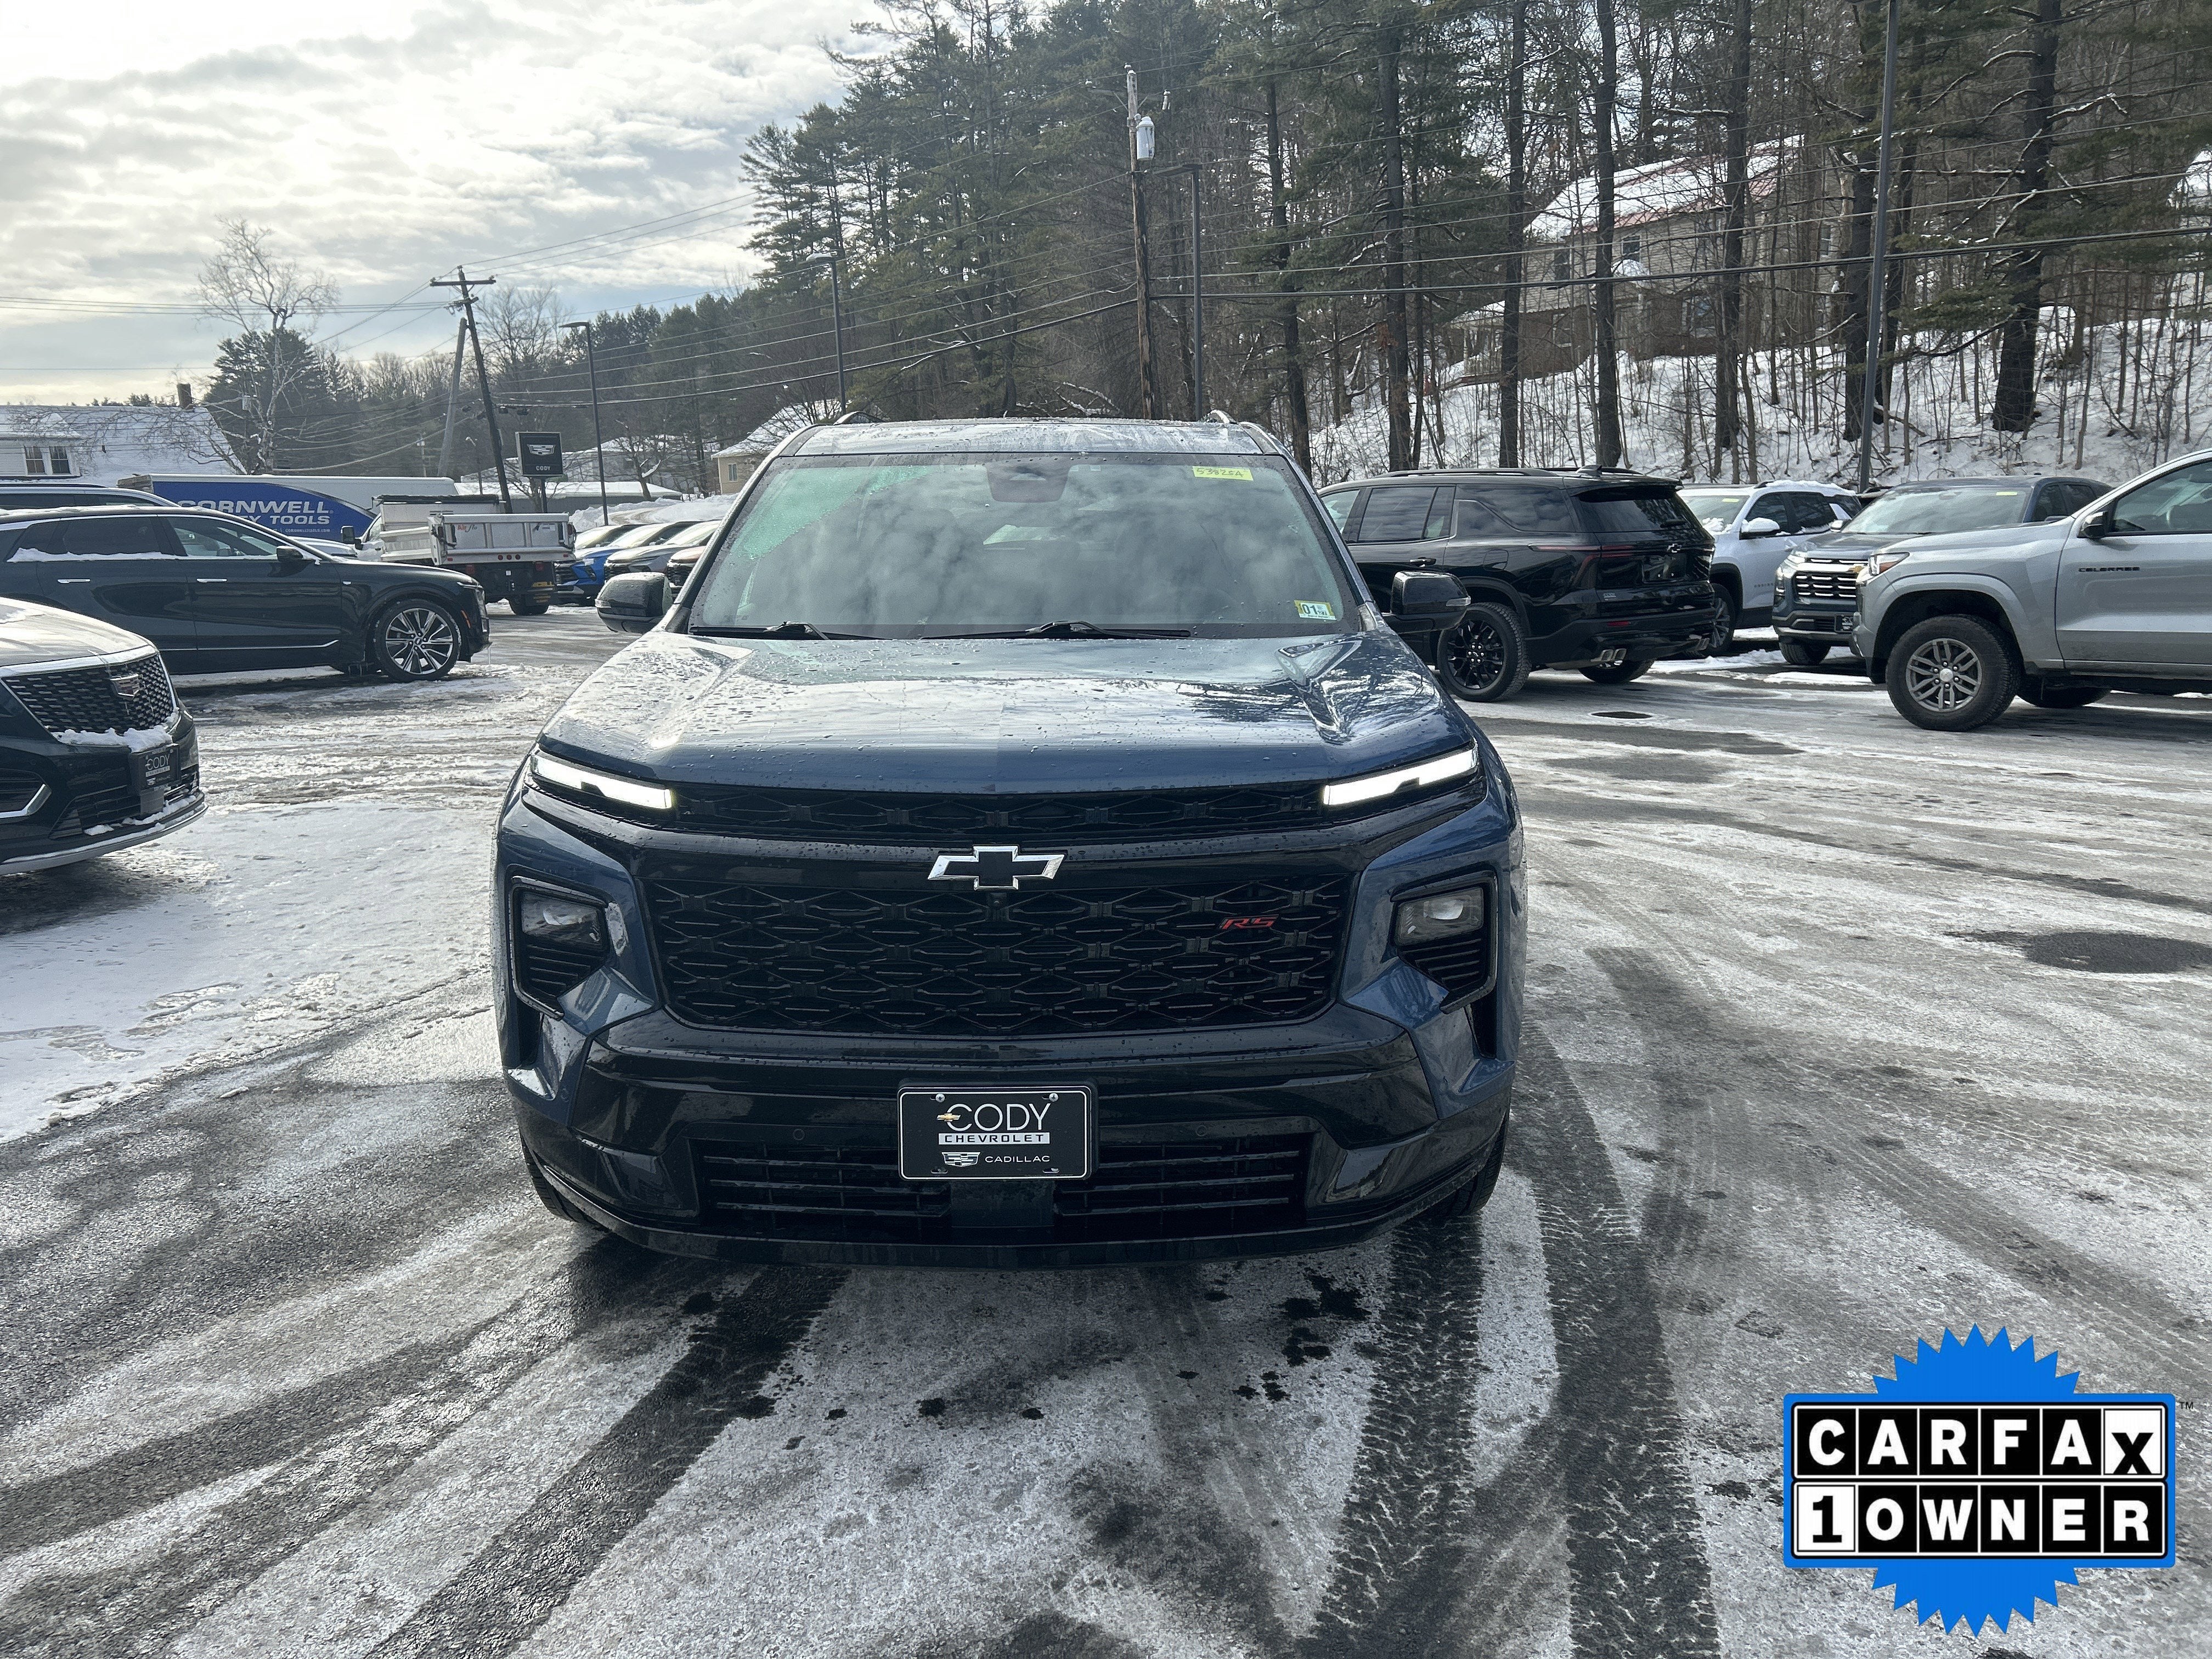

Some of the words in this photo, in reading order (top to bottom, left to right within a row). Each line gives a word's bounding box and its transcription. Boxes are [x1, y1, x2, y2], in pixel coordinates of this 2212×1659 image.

[270, 515, 330, 524] TOOLS
[1301, 604, 1318, 615] 01
[146, 754, 170, 770] CODY
[1220, 915, 1278, 929] RS
[946, 1103, 1051, 1131] CODY
[945, 1134, 1044, 1143] CHEVROLET
